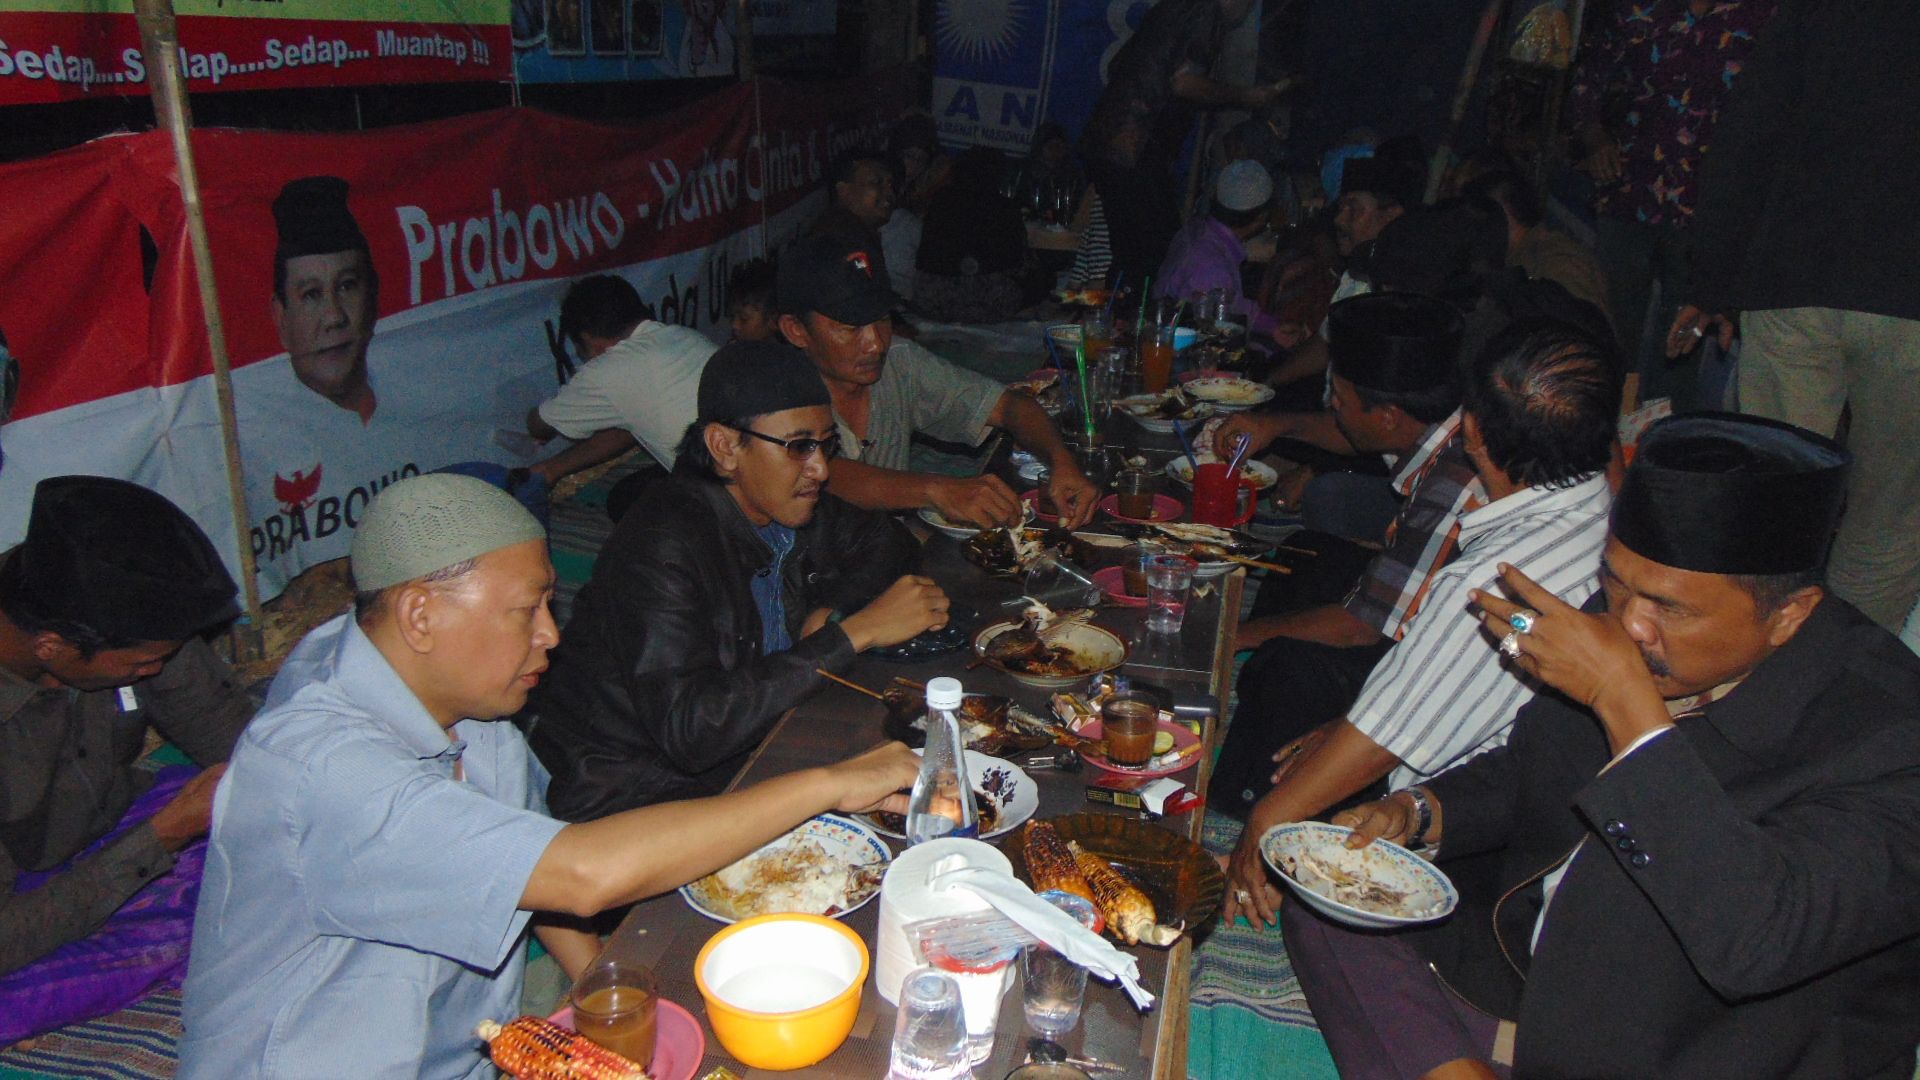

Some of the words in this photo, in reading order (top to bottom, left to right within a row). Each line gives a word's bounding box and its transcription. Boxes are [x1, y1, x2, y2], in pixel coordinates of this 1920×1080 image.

[376, 29, 467, 66] Muantap
[395, 186, 625, 305] Prabowo
[648, 147, 738, 232] Hatta
